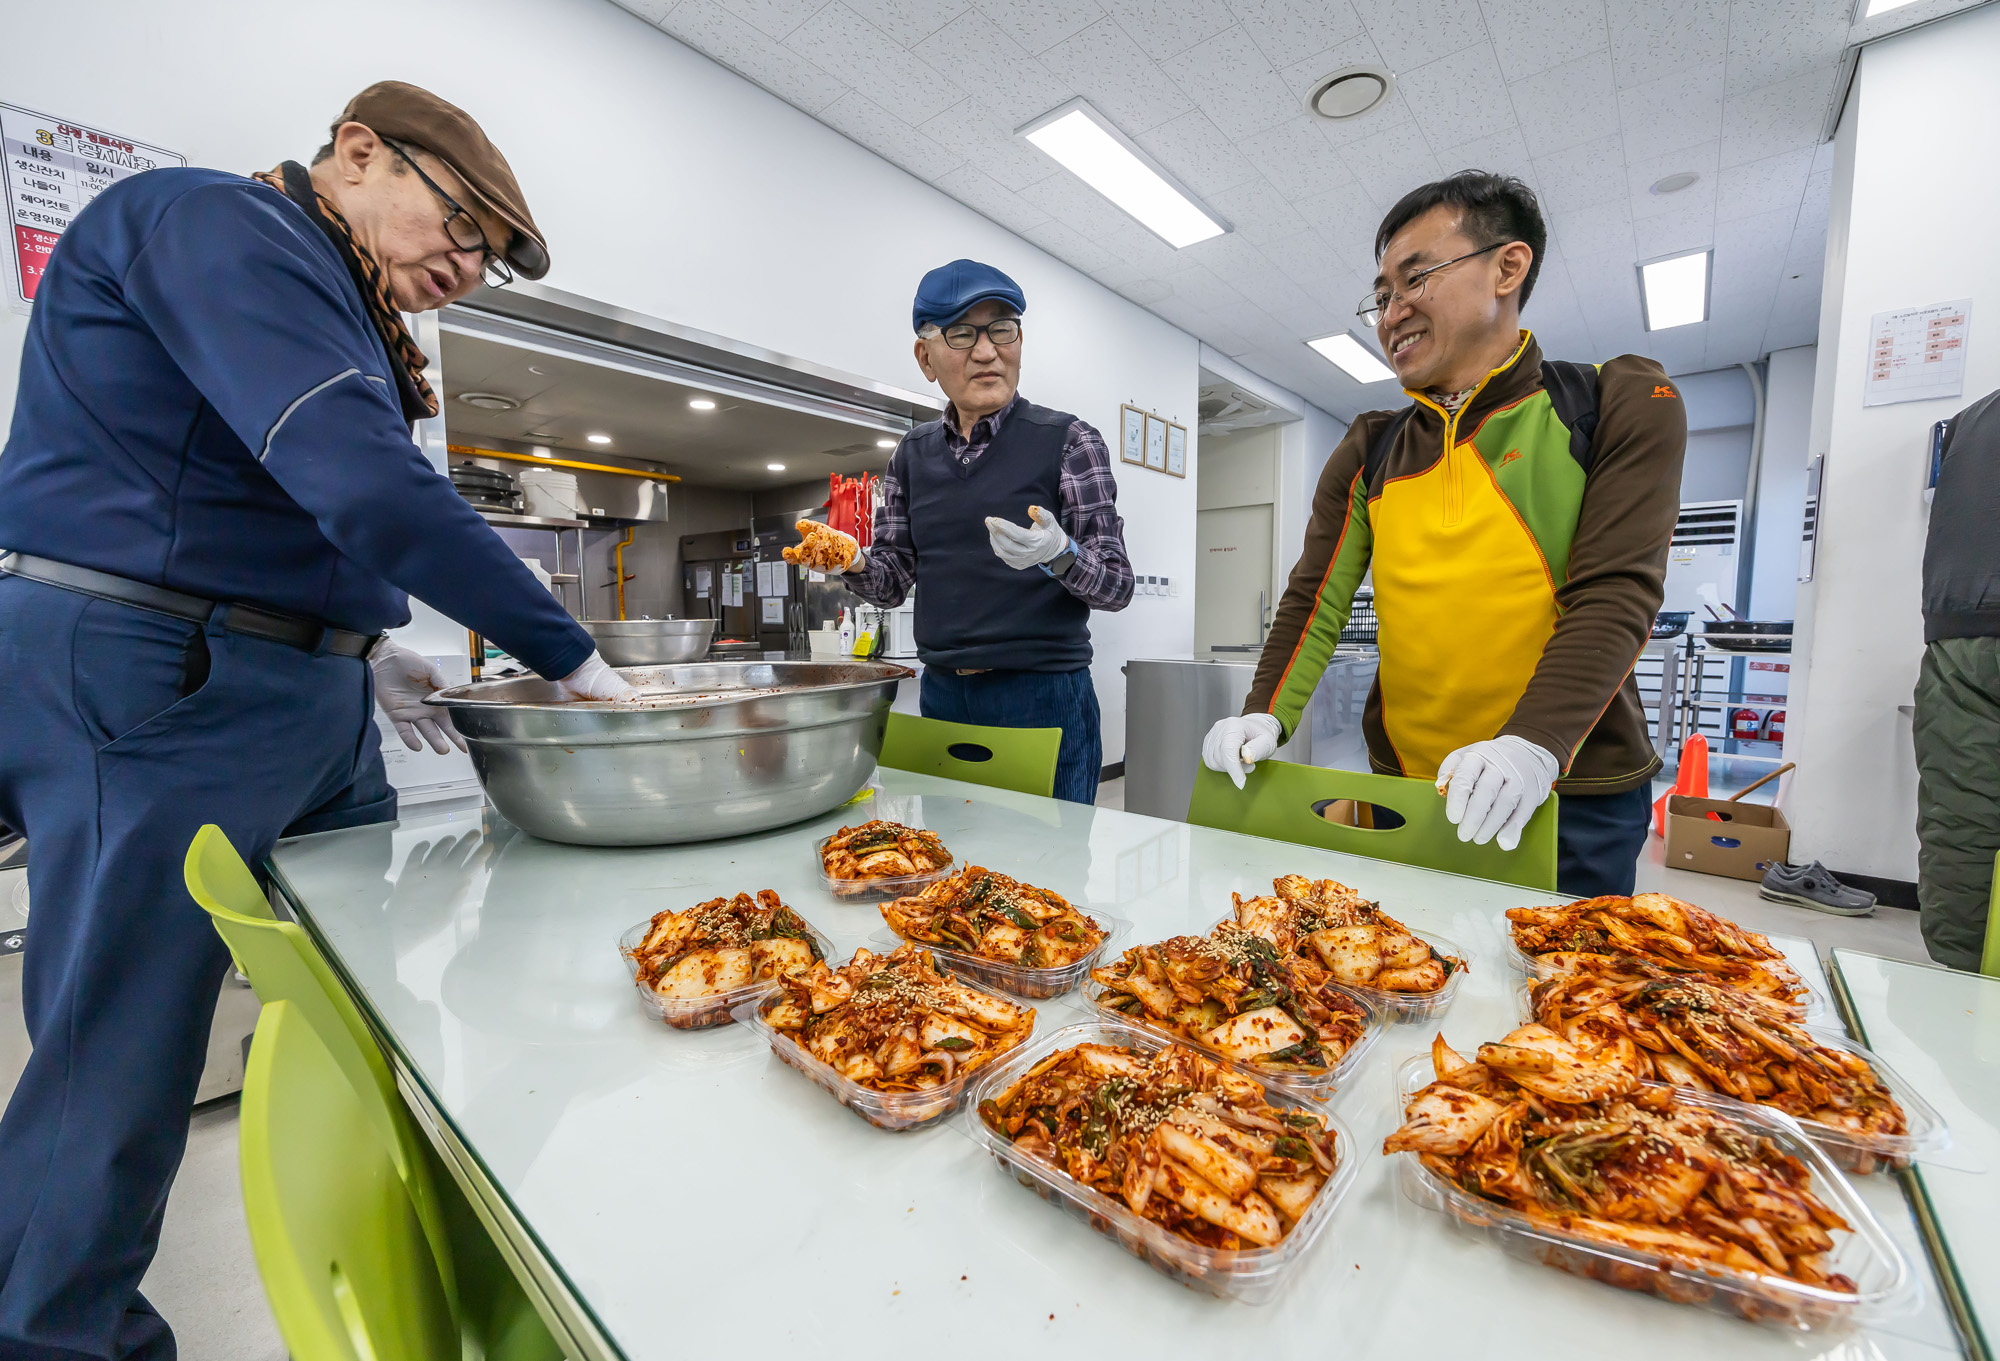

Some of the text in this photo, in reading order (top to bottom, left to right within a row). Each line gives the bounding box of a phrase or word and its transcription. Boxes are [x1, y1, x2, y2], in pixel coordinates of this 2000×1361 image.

[36, 129, 156, 171] 3월 공지사항
[15, 160, 65, 180] 생신잔치
[23, 145, 113, 178] 내용 일시
[23, 177, 61, 194] 나들이
[20, 194, 71, 212] 헤어컷트
[17, 209, 70, 228] 운영위원
